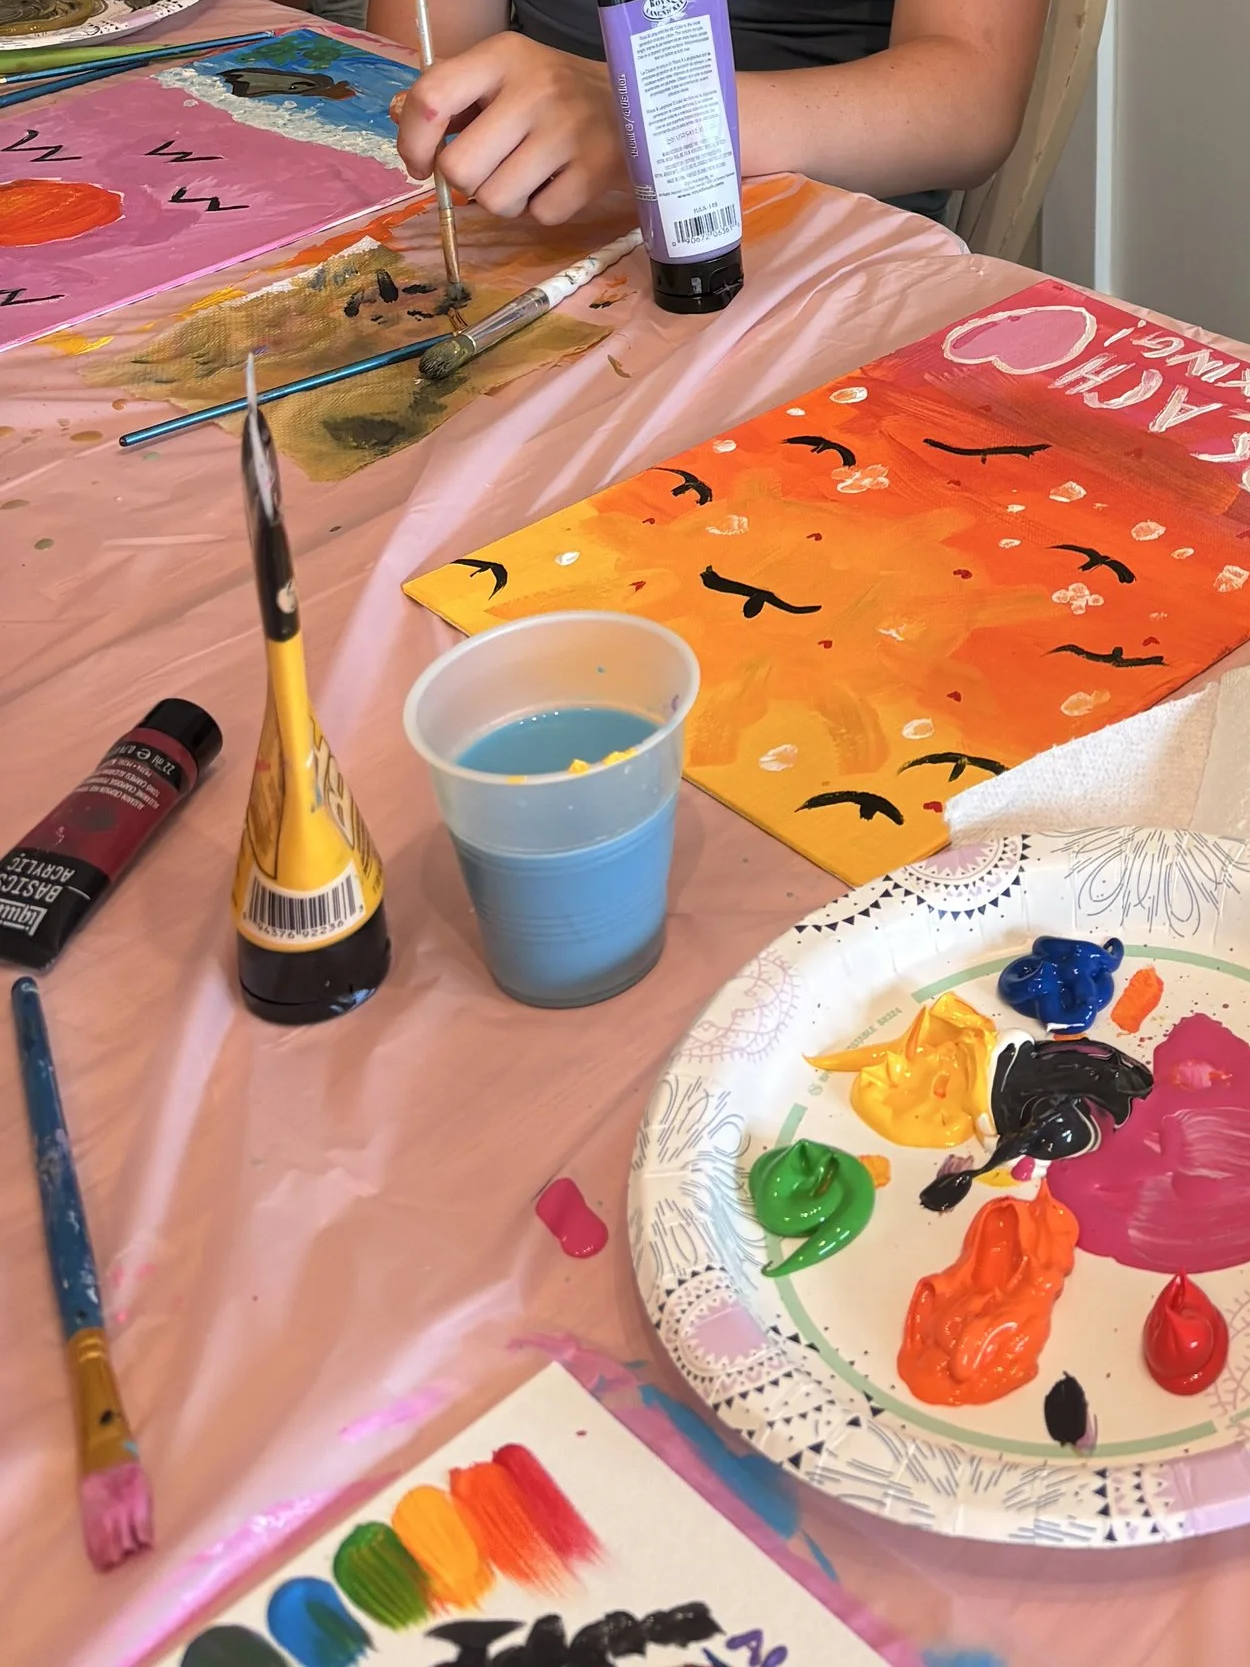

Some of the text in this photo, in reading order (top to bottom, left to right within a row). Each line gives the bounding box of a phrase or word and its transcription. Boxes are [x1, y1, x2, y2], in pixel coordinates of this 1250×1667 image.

[163, 762, 176, 776] 22
[7, 856, 76, 883] ACRYLIC
[0, 898, 49, 937] Liqui
